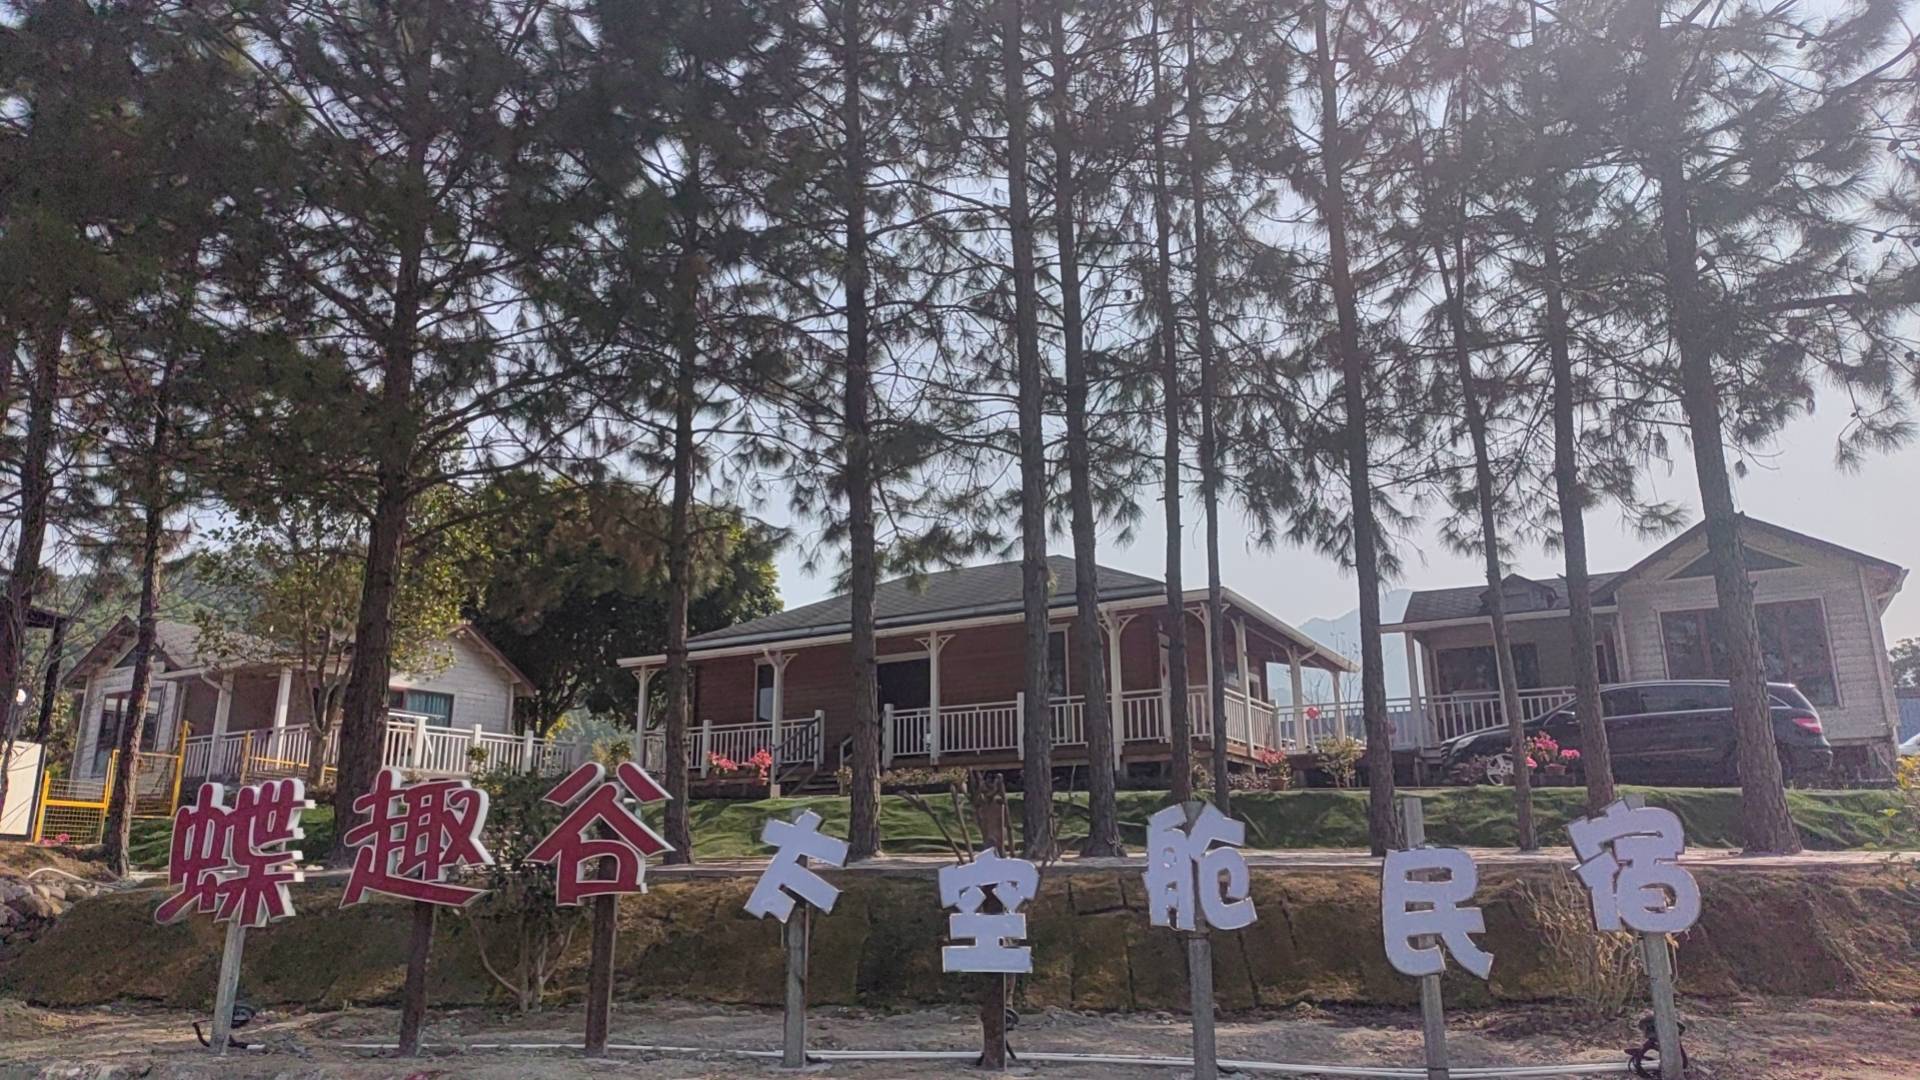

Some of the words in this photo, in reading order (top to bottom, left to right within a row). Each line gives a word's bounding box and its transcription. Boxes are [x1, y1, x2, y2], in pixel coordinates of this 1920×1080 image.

[154, 762, 676, 928] 蝶趣谷
[743, 799, 1701, 980] 太空舱民宿
